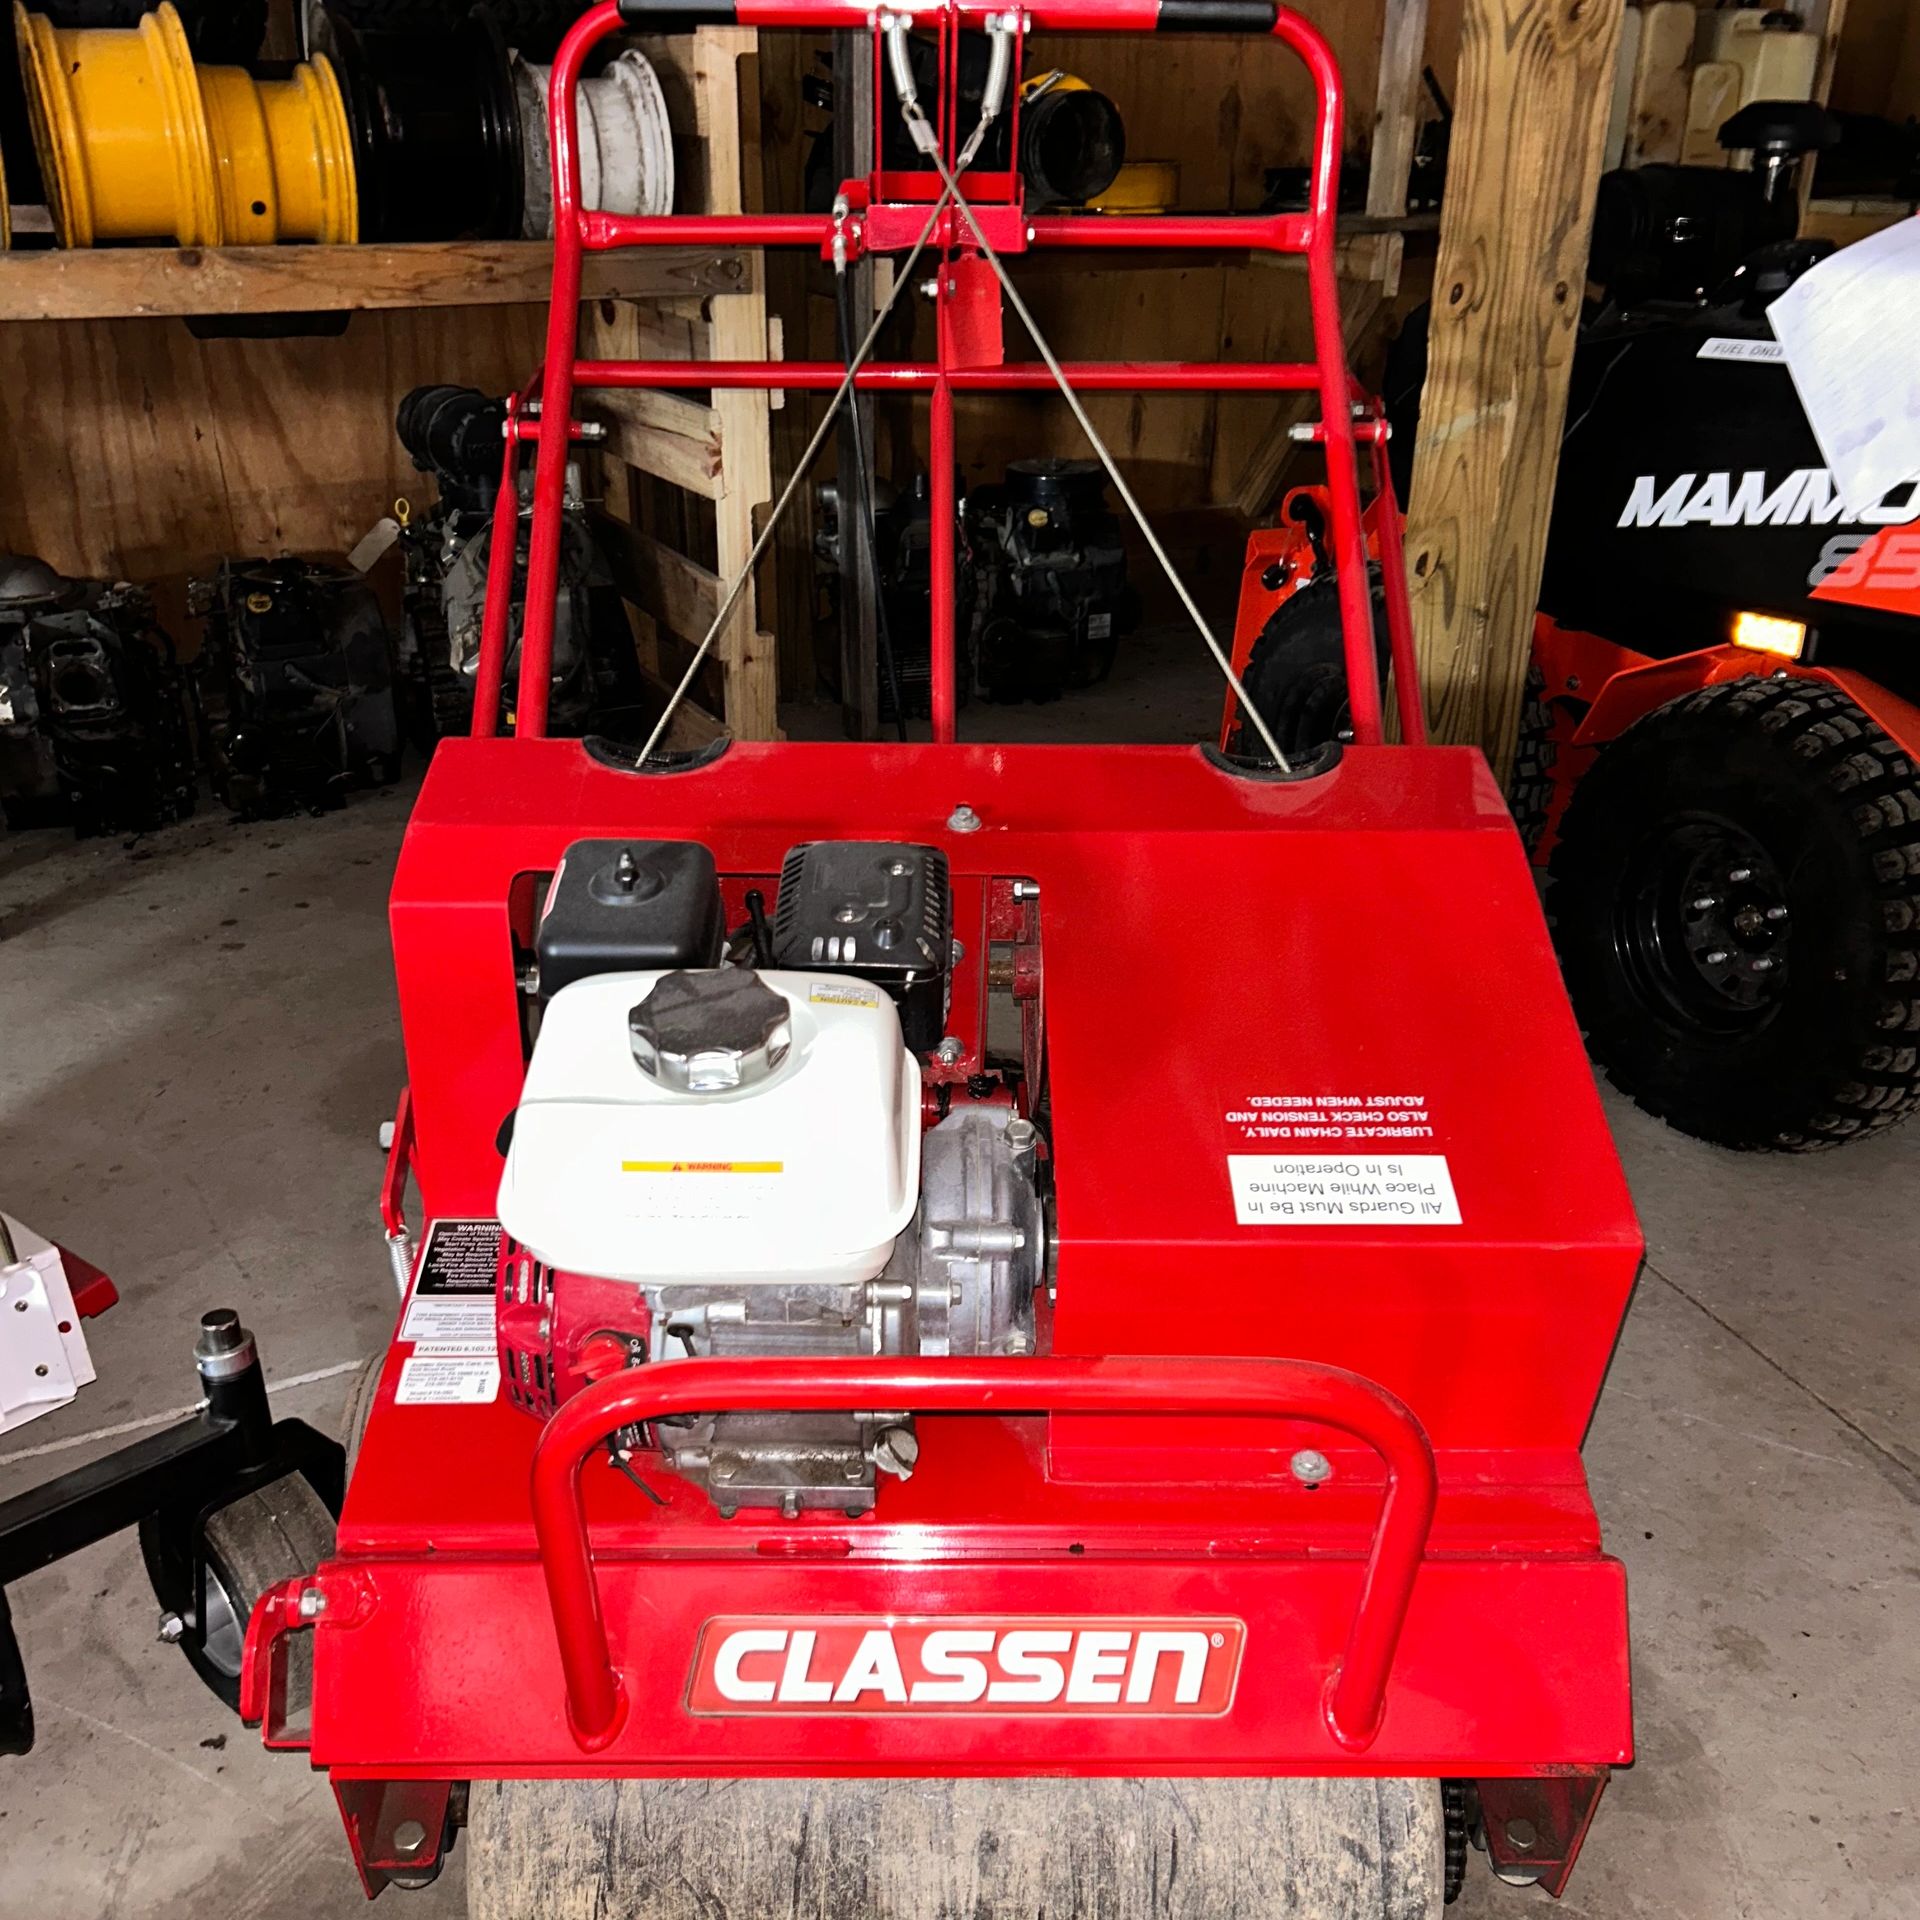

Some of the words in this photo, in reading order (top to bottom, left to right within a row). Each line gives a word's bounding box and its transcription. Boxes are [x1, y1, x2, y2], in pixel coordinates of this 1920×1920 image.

[1711, 342, 1745, 354] FUEL
[1246, 1096, 1314, 1107] NEEDED.
[1316, 1096, 1363, 1106] WHEN
[1365, 1096, 1425, 1106] ADJUST
[1225, 1111, 1258, 1122] AND
[1261, 1111, 1328, 1122] TENSION
[1333, 1111, 1384, 1122] CHECK
[1387, 1111, 1428, 1122] ALSO
[1240, 1125, 1292, 1138] DAILY,
[1294, 1127, 1343, 1137] CHAIN
[1345, 1126, 1433, 1137] LUBRICATE
[687, 1161, 732, 1171] WARNING
[1273, 1162, 1360, 1176] Operation
[1366, 1164, 1382, 1175] In
[1388, 1164, 1403, 1175] Is
[1249, 1182, 1325, 1195] Machine
[1330, 1182, 1380, 1195] While
[1385, 1183, 1436, 1195] Place
[1247, 1202, 1264, 1214] In
[1270, 1202, 1295, 1214] Be
[1300, 1202, 1343, 1214] Must
[1349, 1202, 1415, 1214] Guards
[1421, 1202, 1443, 1214] All
[418, 1345, 463, 1353] PATENTED
[714, 1629, 1210, 1704] CLASSEN
